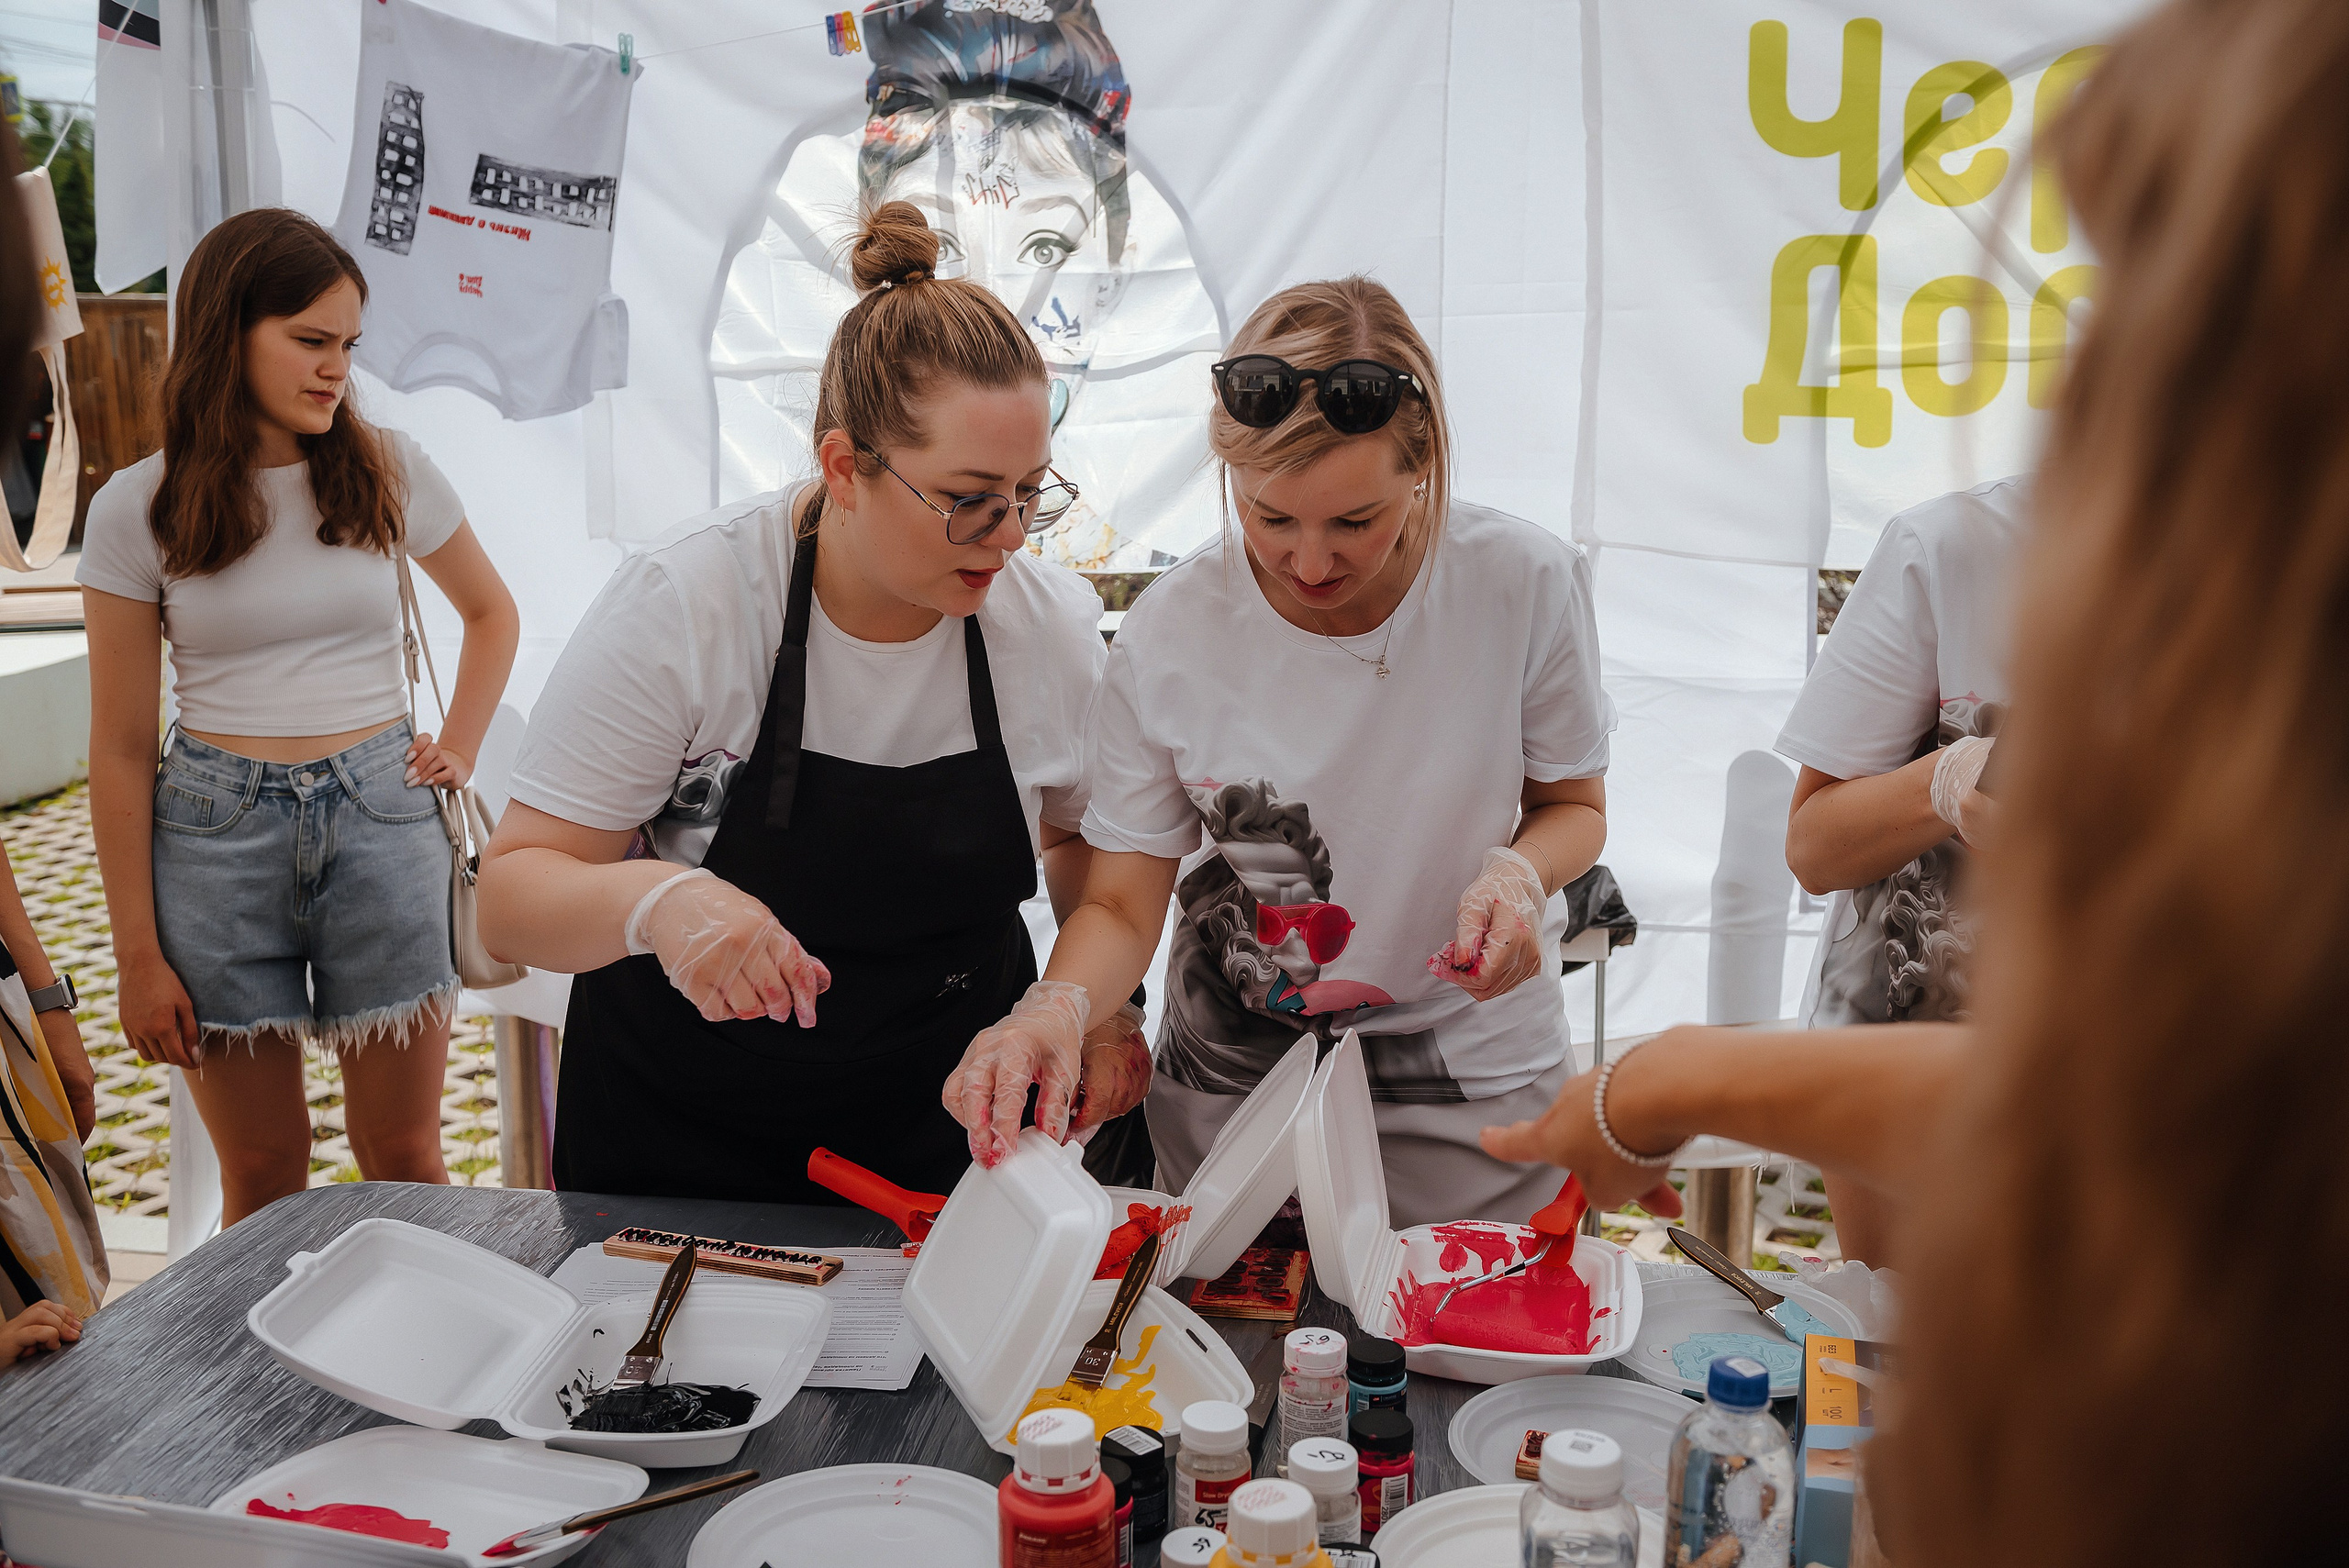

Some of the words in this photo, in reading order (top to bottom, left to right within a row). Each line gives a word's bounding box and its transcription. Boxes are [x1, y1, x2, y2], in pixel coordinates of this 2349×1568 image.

[1108, 1303, 1124, 1326] MALEVICH
[1085, 1356, 1102, 1366] 30
[1830, 1406, 1842, 1419] 100
[1195, 1508, 1222, 1529] 65
